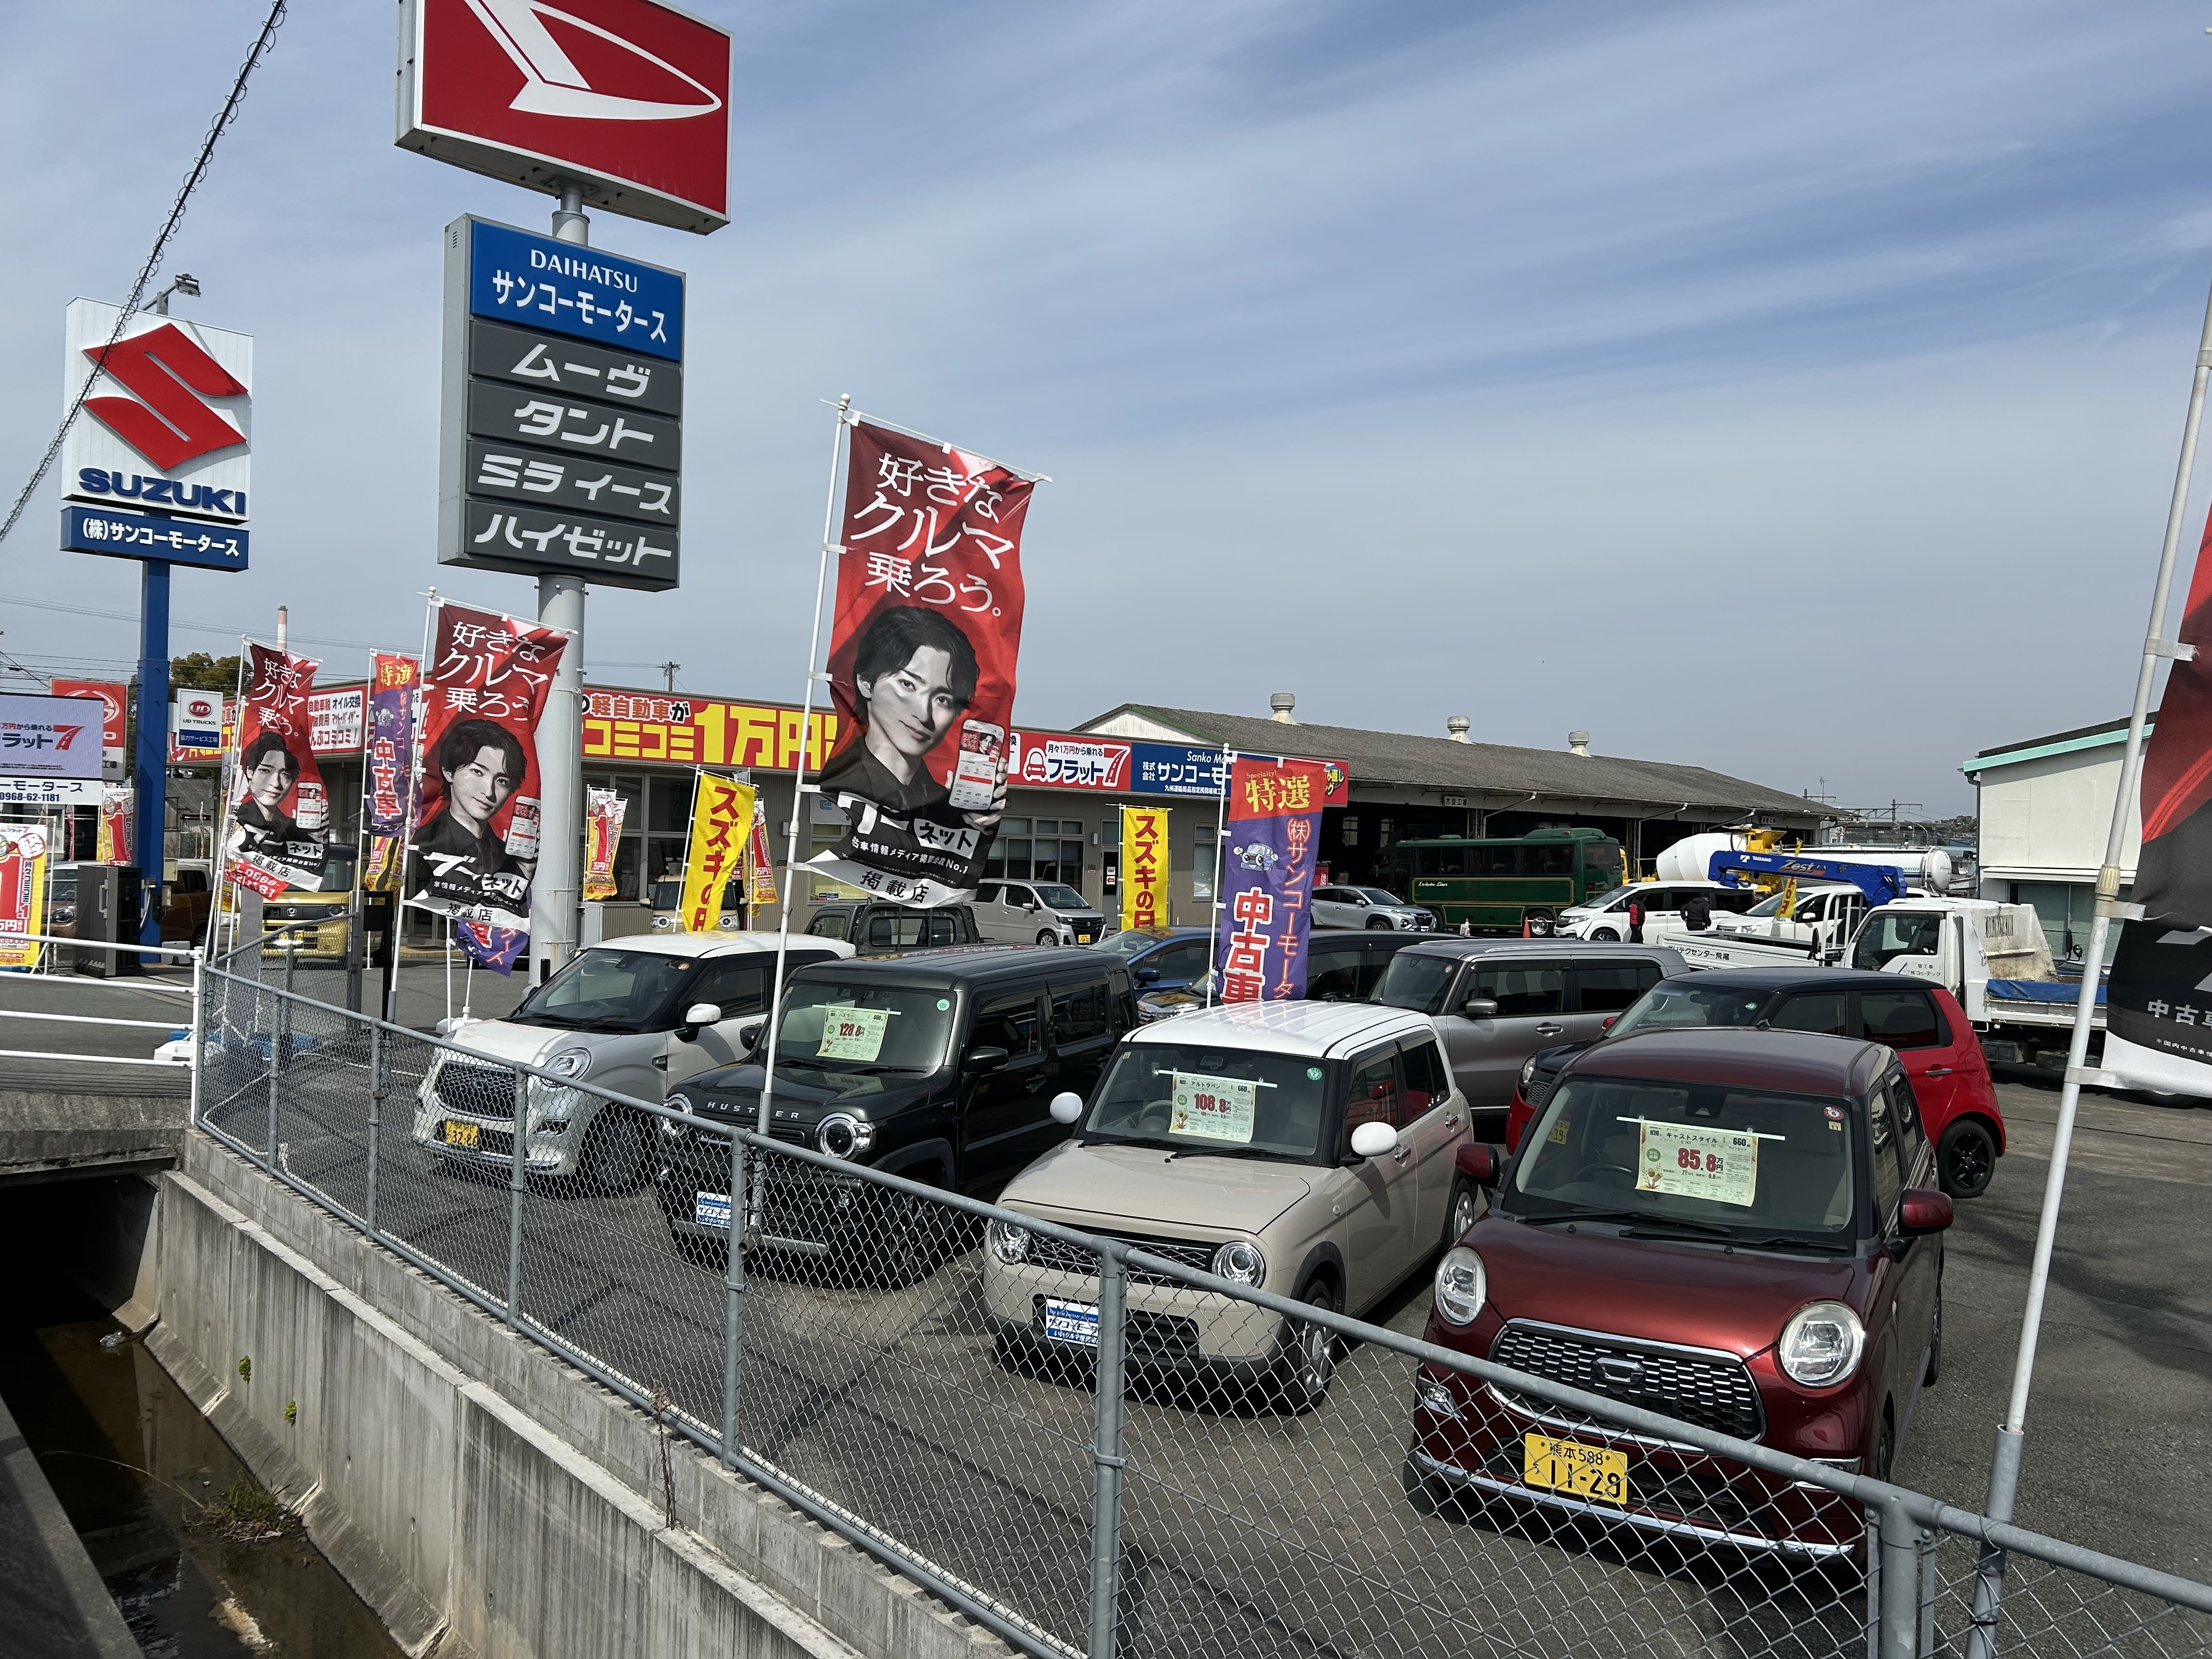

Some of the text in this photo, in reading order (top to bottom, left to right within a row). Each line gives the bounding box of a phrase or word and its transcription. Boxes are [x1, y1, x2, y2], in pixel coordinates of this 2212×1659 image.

[531, 249, 638, 293] DAIHATSU
[492, 269, 667, 343] サンコーモータース
[510, 343, 651, 398] ムーヴ
[514, 400, 654, 450] タント
[78, 467, 246, 515] SUZUKI
[477, 453, 673, 515] ミラ イース
[876, 452, 1003, 524] 好きな
[82, 517, 240, 557] (株)サンコーモータース
[474, 514, 672, 566] ハイゼット
[850, 491, 1015, 570] クルマ
[865, 551, 1002, 618] 乗ろう。
[452, 621, 545, 663] 好きな
[264, 657, 302, 689] 好きな
[380, 664, 413, 686] 特選
[436, 647, 549, 695] クルマ
[251, 678, 306, 715] クルマ
[332, 695, 361, 709] オイル交換
[309, 727, 358, 747] んぶコミコミ!
[1047, 744, 1103, 757] 月々1万円から乗れる
[1187, 751, 1212, 763] Sanko
[1246, 770, 1278, 779] Specialty!
[373, 737, 402, 819] 中古車
[1245, 774, 1311, 813] 特選
[252, 854, 292, 877] 掲載店
[1133, 815, 1159, 928] スズキの日
[1779, 859, 1815, 873] Zest
[859, 871, 929, 904] 掲載店
[447, 902, 493, 922] 掲載店
[1220, 887, 1274, 1004] 中古車
[839, 1023, 861, 1037] 128.8
[1190, 1081, 1221, 1089] アルトラパン
[1193, 1093, 1226, 1113] 108.8
[707, 1101, 800, 1119] HUSTER
[1666, 1132, 1718, 1143] キャストスタイル
[1733, 1137, 1746, 1147] 660
[1677, 1147, 1717, 1172] 85.8
[1716, 1157, 1724, 1171] 万円
[1550, 1459, 1621, 1498] 11-29
